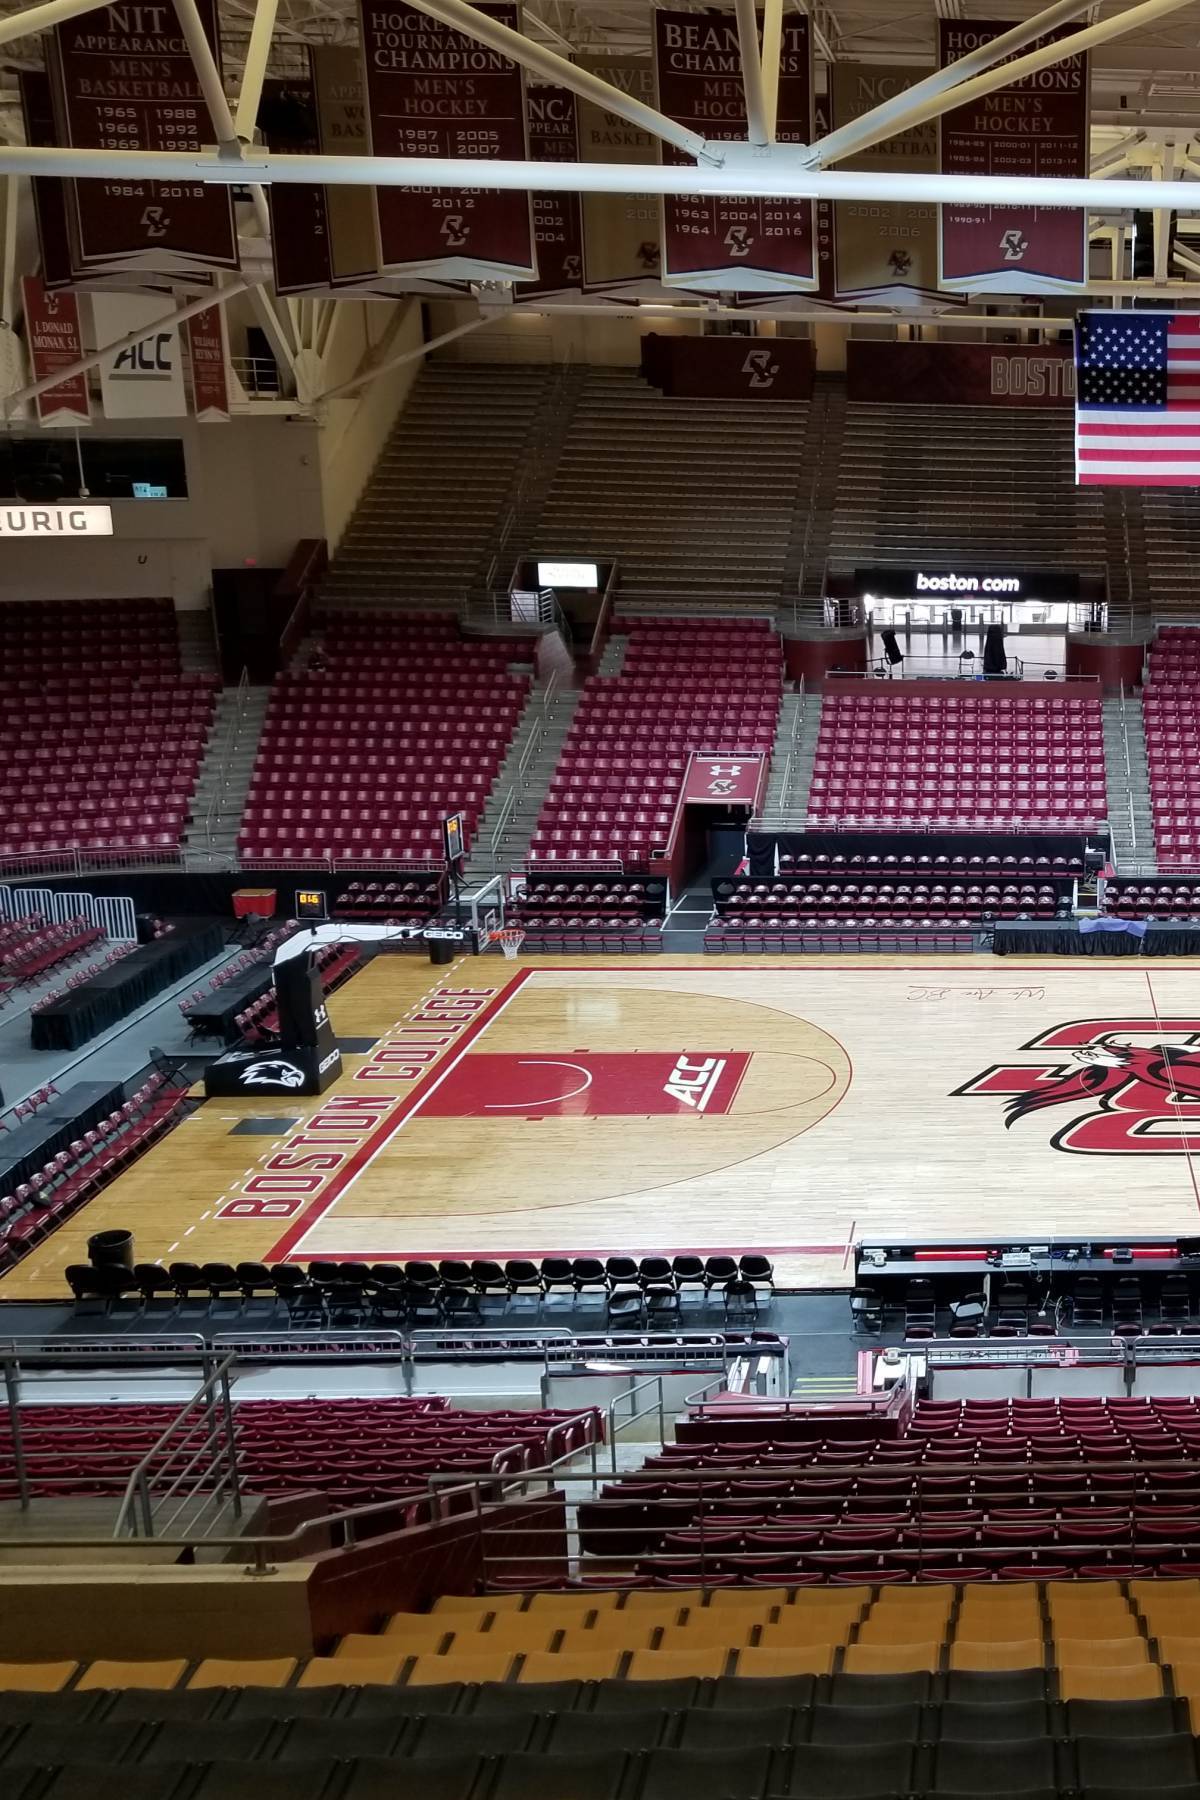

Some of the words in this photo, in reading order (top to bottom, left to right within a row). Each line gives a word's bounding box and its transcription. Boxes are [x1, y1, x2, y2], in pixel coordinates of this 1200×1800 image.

[106, 6, 166, 34] NIT
[372, 12, 453, 32] HOCKE
[74, 34, 191, 52] APPEARANCE
[372, 32, 491, 50] TOURNAM
[664, 23, 805, 52] BEANT
[946, 32, 998, 49] HOC
[374, 49, 517, 70] CHAMPIONS
[670, 53, 798, 73] CHAMNS
[109, 60, 172, 77] MEN'S
[413, 79, 476, 95] MEN'S
[593, 67, 653, 92] SWE
[1008, 71, 1081, 89] PIONS
[704, 81, 745, 98] MEN
[857, 76, 919, 100] NCA
[96, 106, 136, 118] 1965
[156, 108, 197, 119] 1988
[403, 99, 488, 115] HOCKEY
[527, 98, 575, 121] NCA
[694, 101, 747, 118] HOC
[984, 97, 1043, 113] MEN'S
[97, 123, 138, 134] 1966
[157, 124, 197, 135] 1992
[974, 116, 1054, 132] HOCKEY
[399, 129, 438, 140] 1987
[456, 131, 499, 141] 2005
[592, 131, 652, 145] BASKET
[99, 138, 139, 149] 1969
[158, 140, 198, 150] 1993
[400, 142, 440, 154] 1990
[457, 144, 500, 155] 2007
[543, 141, 576, 155] MEN
[104, 185, 144, 197] 1984
[160, 187, 204, 198] 2018
[432, 198, 476, 209] 2012
[533, 199, 560, 210] 001
[534, 216, 564, 226] 002
[625, 208, 658, 220] 200
[675, 209, 709, 220] 1963
[720, 211, 757, 221] 2004
[765, 211, 802, 221] 2014
[908, 208, 937, 219] 200
[535, 232, 565, 243] 004
[675, 224, 710, 235] 1964
[880, 225, 921, 237] 2006
[113, 333, 173, 371] ACC
[990, 356, 1075, 397] BOSTO
[0, 511, 88, 531] URIG
[424, 930, 464, 940] GEICO
[353, 985, 499, 1082] COLLEGE
[318, 1048, 340, 1074] GEICO
[662, 1054, 716, 1107] ACC
[216, 1095, 399, 1219] BOSTON
